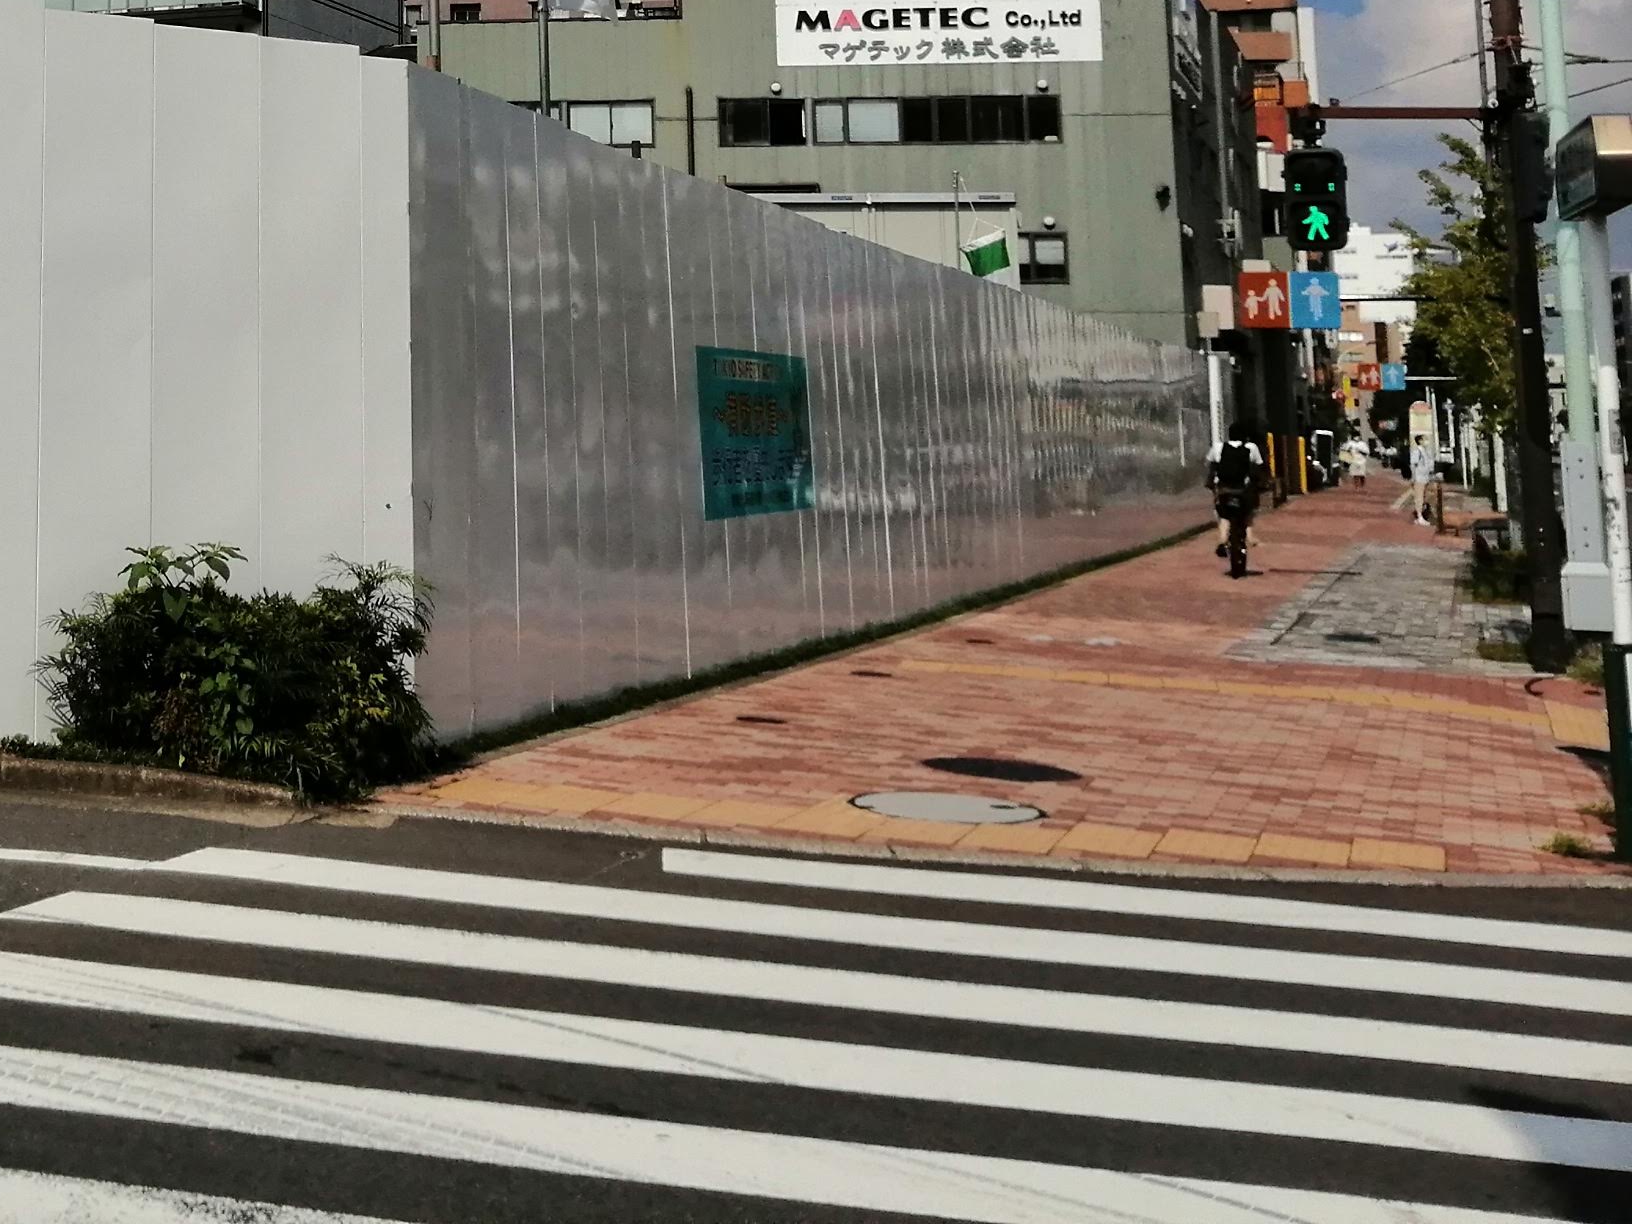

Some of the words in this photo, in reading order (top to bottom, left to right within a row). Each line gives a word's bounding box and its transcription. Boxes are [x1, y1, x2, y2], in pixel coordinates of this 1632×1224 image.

[795, 7, 990, 32] MAGETEC
[1005, 10, 1082, 29] Co.,Ltd
[818, 36, 1060, 62] マゲテック株式会社
